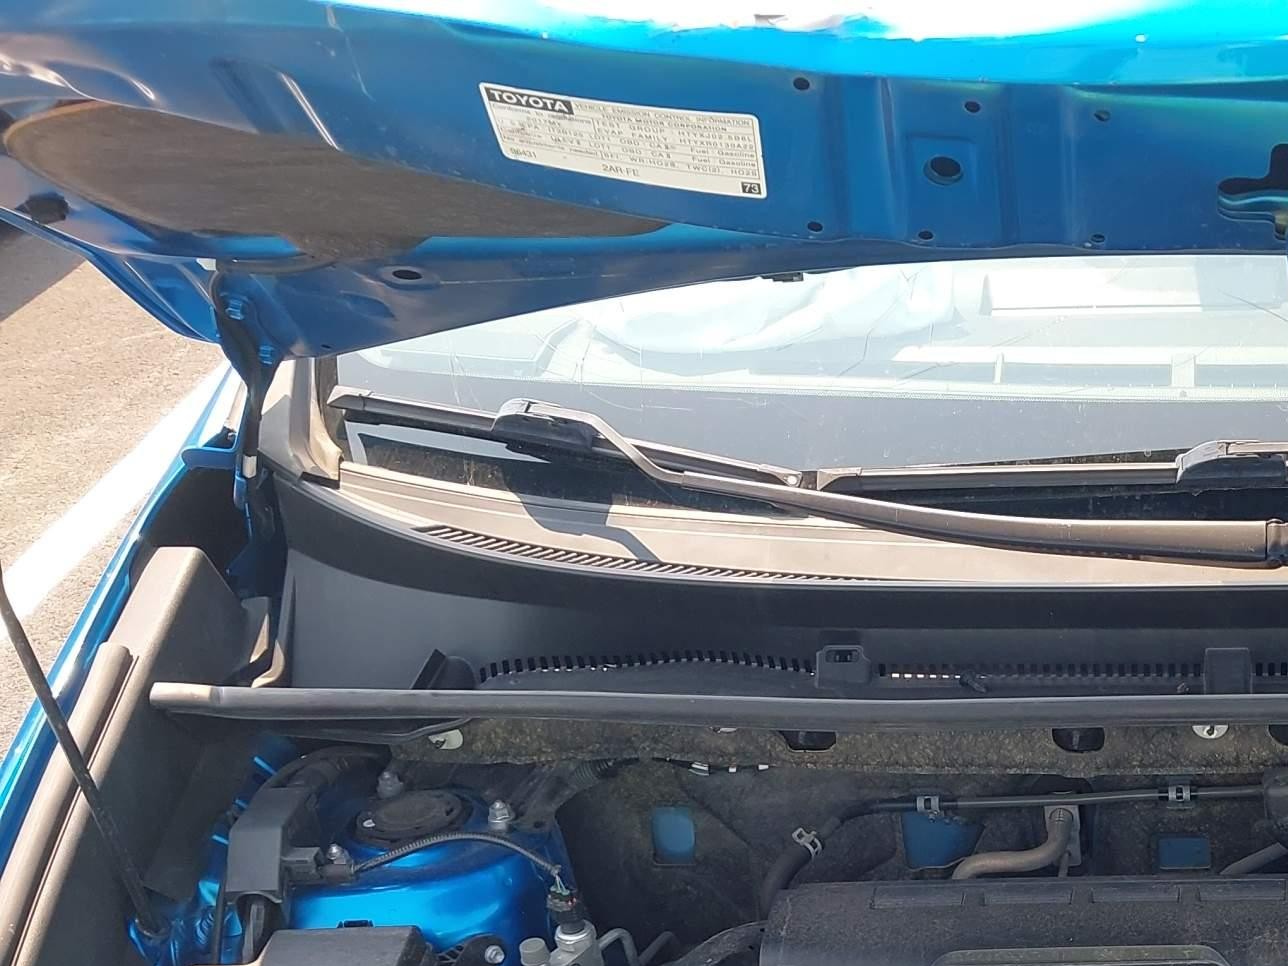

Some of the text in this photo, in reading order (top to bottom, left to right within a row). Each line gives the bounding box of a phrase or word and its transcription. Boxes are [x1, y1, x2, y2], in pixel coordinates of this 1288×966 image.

[489, 89, 569, 113] TOYOTA
[667, 121, 728, 132] CORPORATION
[717, 149, 755, 159] Gasoline
[742, 182, 760, 194] 73
